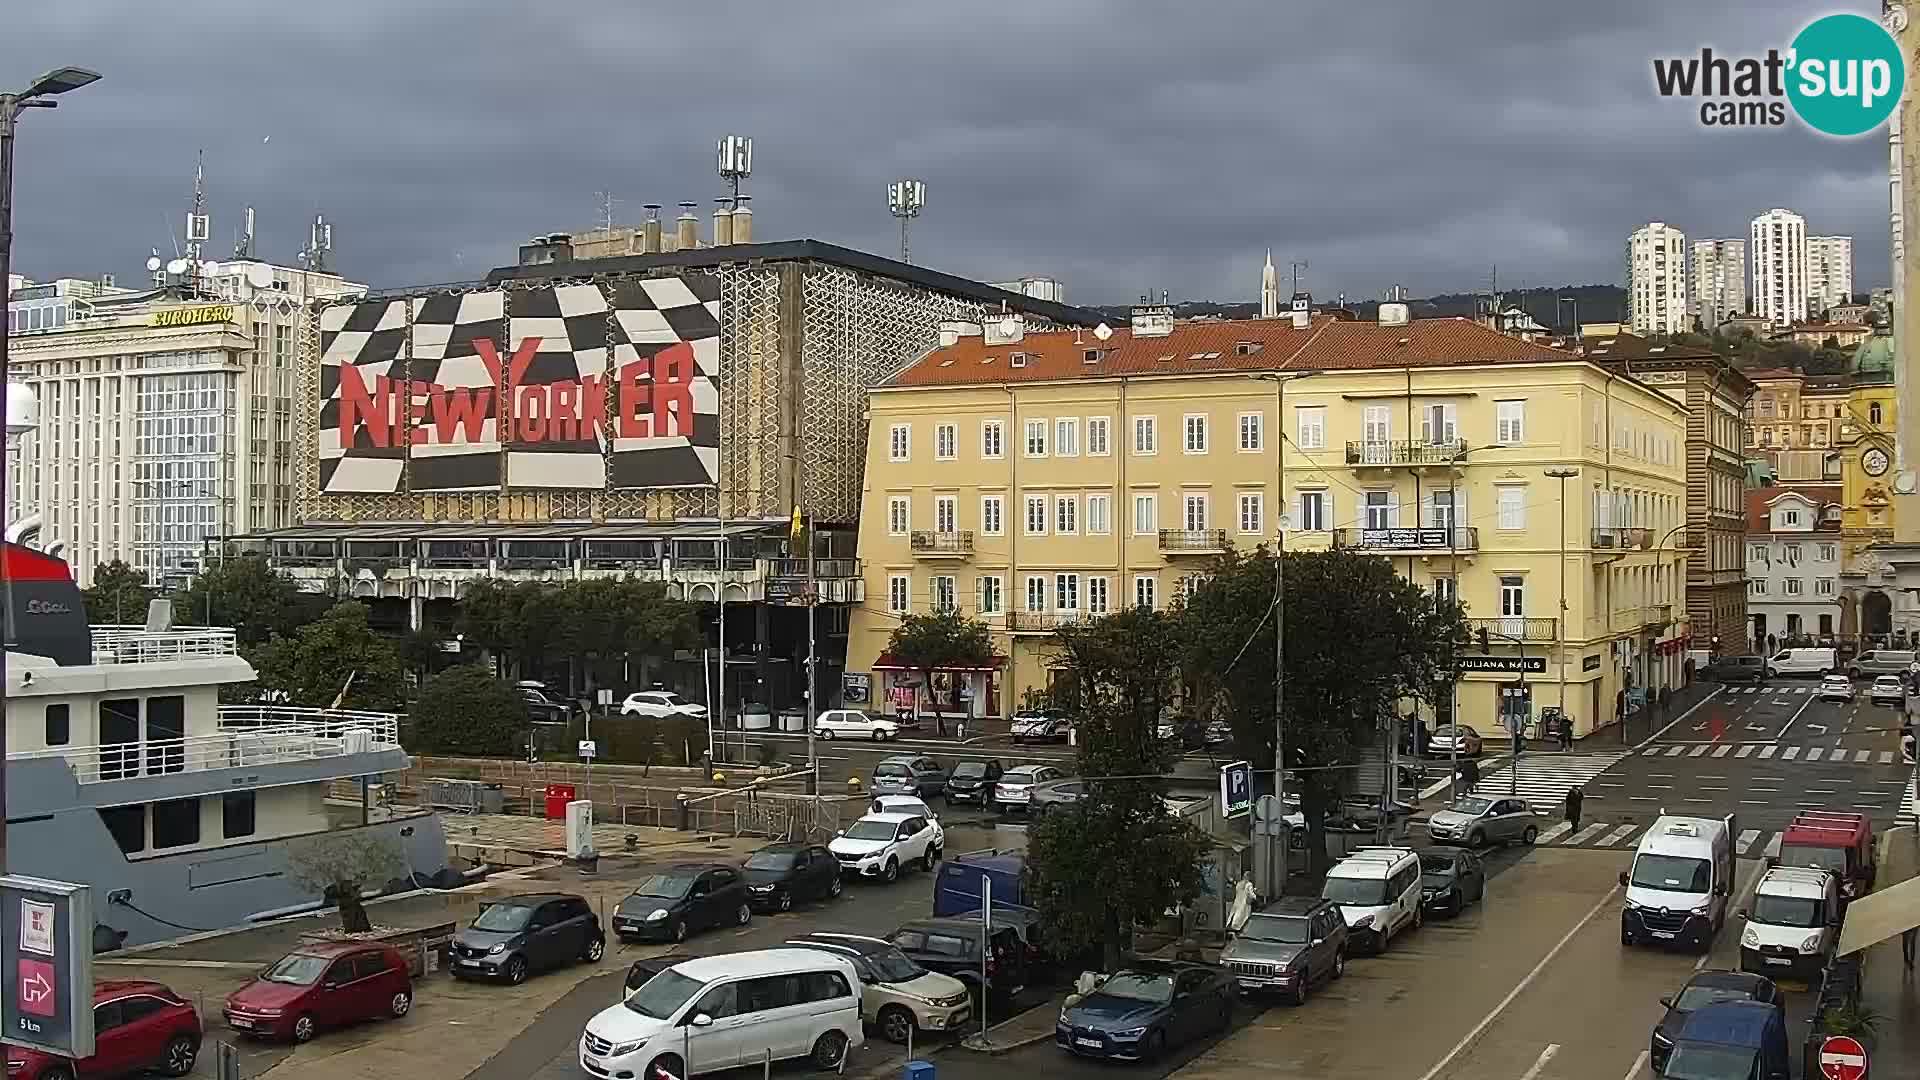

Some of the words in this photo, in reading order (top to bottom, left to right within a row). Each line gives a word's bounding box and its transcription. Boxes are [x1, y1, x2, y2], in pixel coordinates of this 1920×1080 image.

[339, 359, 493, 449] NEW
[1458, 661, 1505, 669] JULIANA
[1509, 661, 1541, 669] NAILS
[1232, 769, 1244, 794] P
[20, 1018, 26, 1029] 5
[27, 1019, 41, 1033] km
